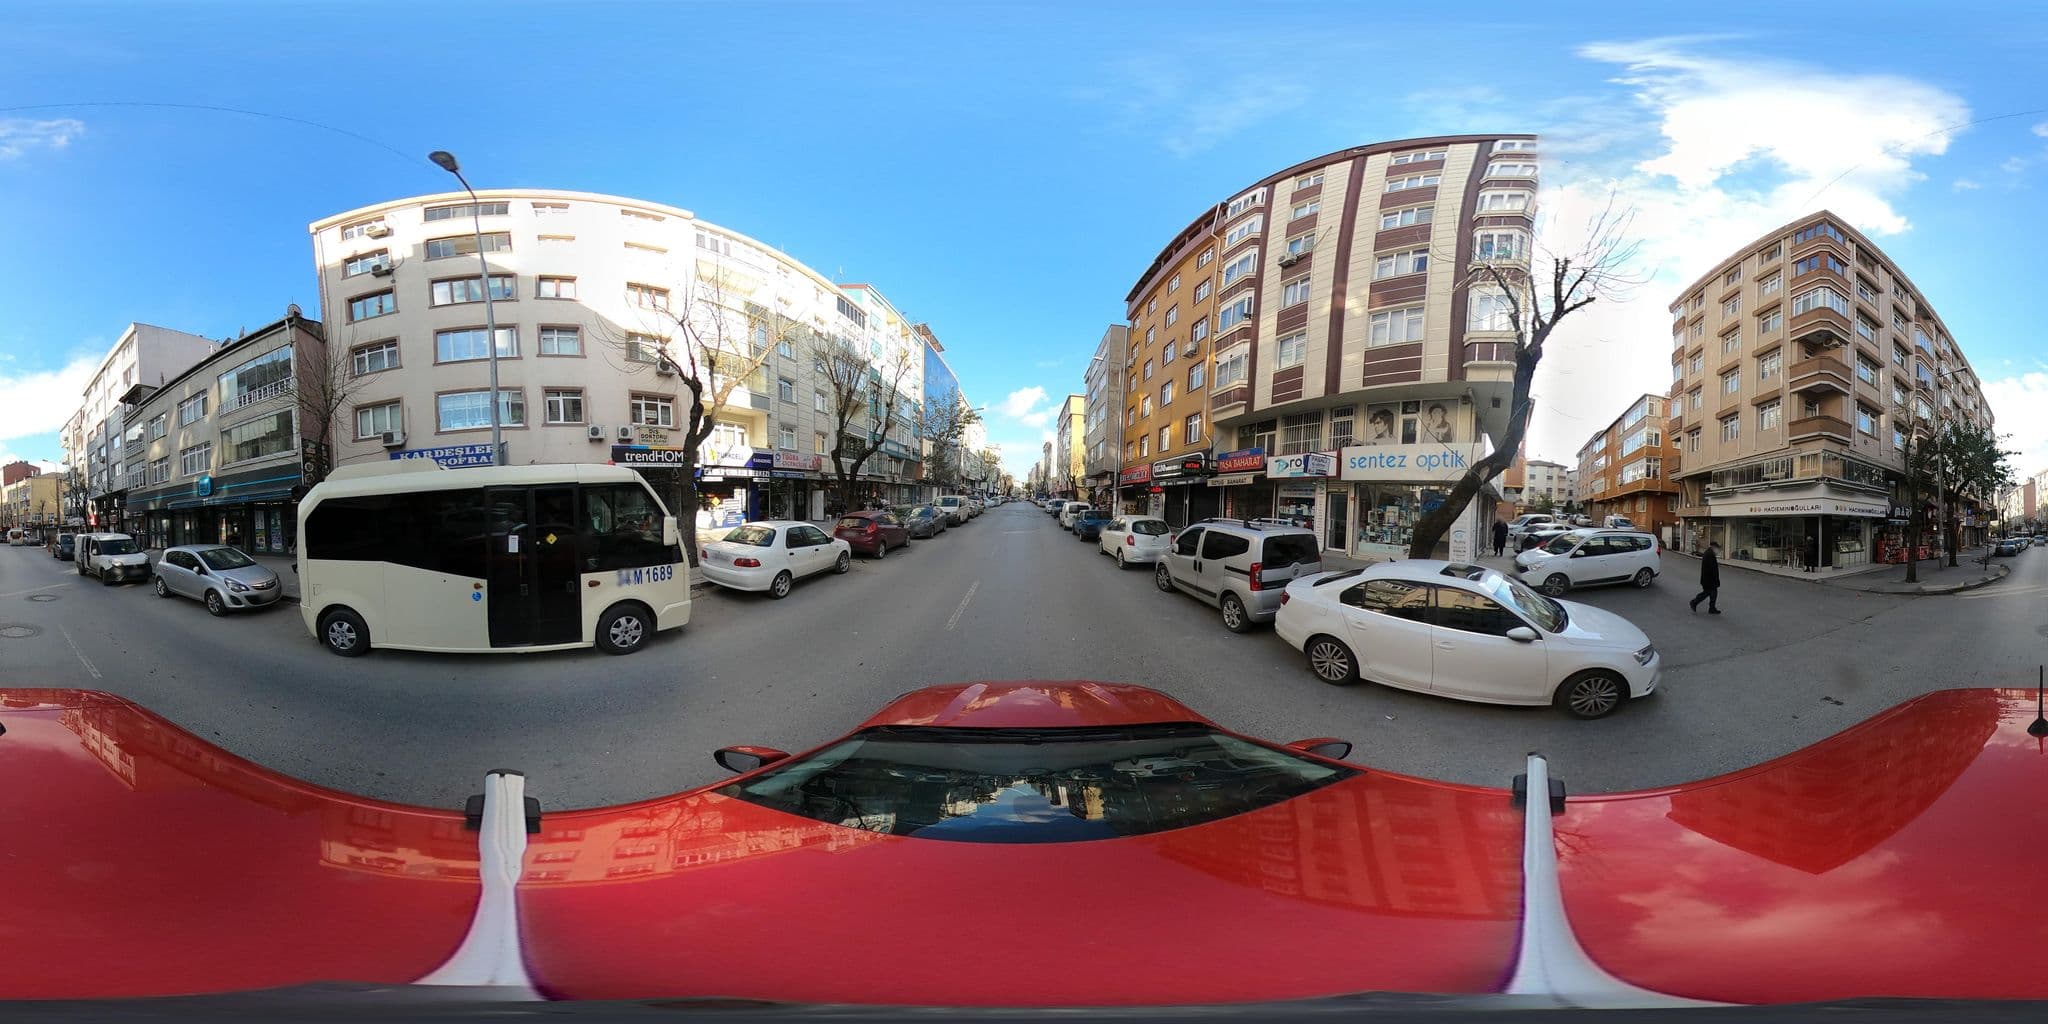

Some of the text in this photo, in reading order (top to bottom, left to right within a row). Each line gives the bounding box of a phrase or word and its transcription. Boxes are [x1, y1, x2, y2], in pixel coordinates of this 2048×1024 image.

[1350, 450, 1465, 471] sentez optik
[646, 565, 673, 583] 1689
